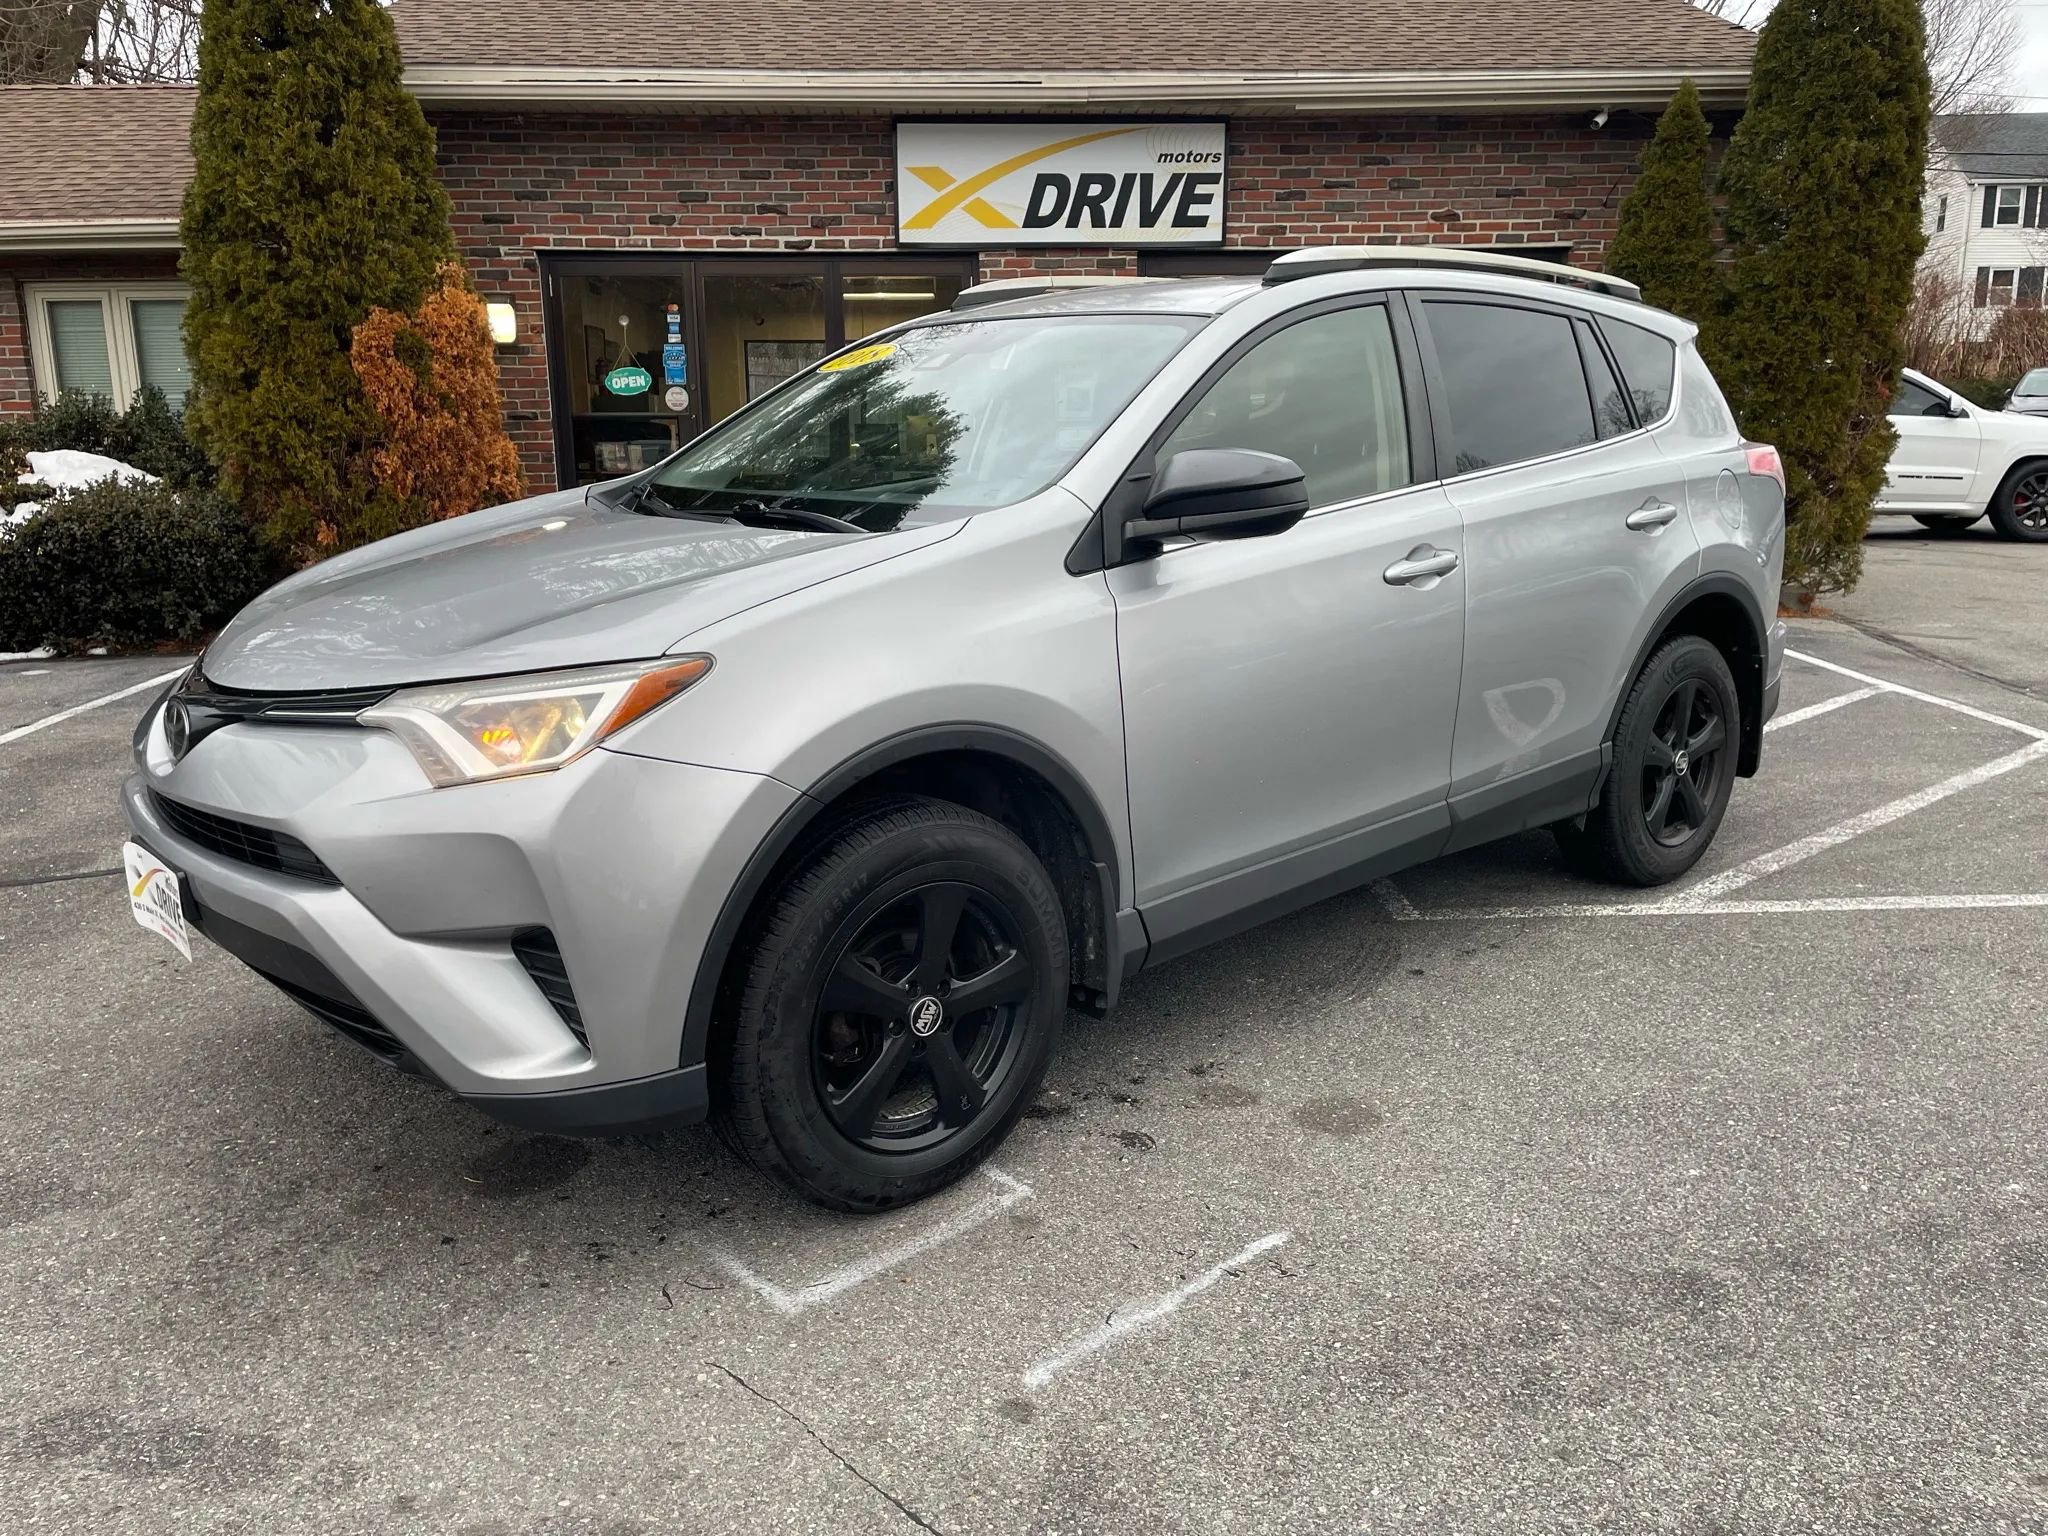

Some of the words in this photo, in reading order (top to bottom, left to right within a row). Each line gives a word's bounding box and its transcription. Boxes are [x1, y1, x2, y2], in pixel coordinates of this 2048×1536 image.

[1157, 149, 1222, 164] motors
[1022, 172, 1223, 229] DRIVE
[612, 375, 646, 389] OPEN
[915, 1000, 937, 1032] MSW
